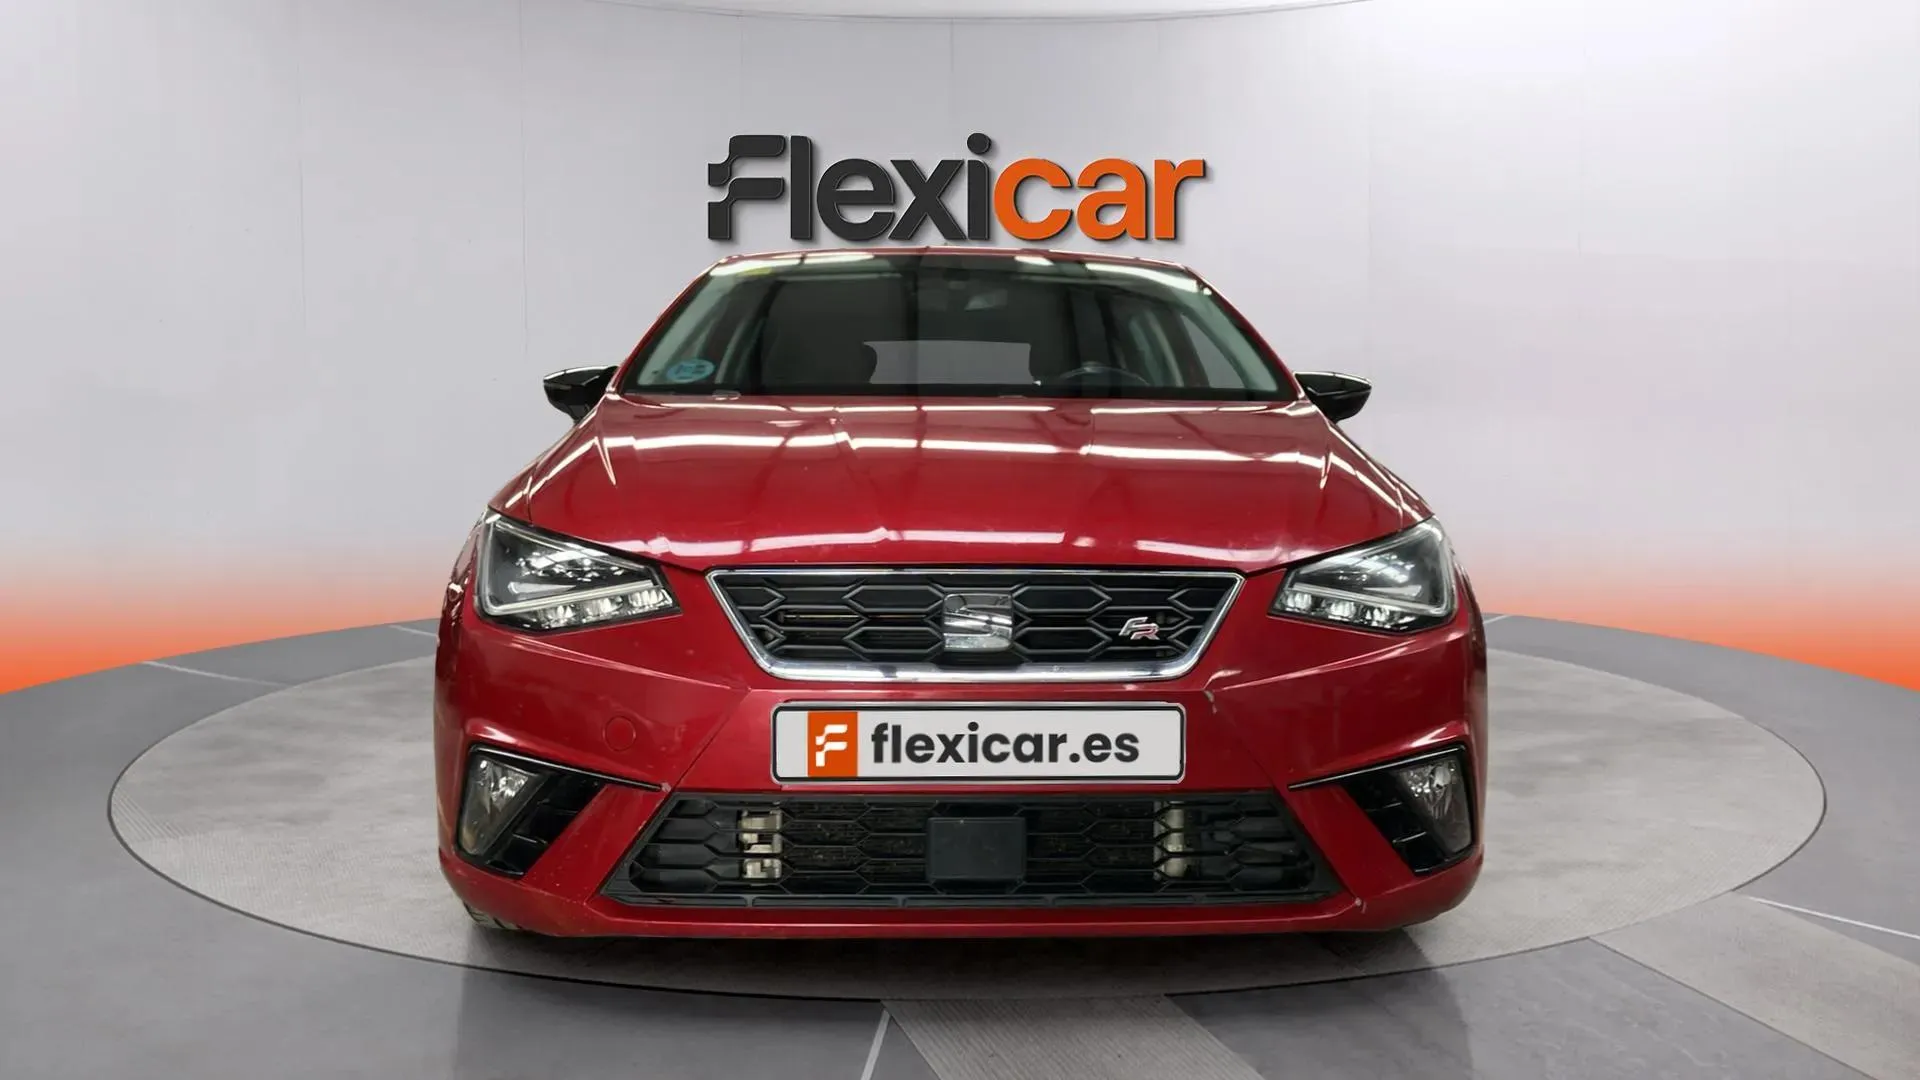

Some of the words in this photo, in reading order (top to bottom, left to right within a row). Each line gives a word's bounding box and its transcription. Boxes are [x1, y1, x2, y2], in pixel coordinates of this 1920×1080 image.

[708, 132, 1205, 241] Flexicar
[1118, 616, 1161, 641] FR
[871, 721, 1140, 764] flexicar.es
